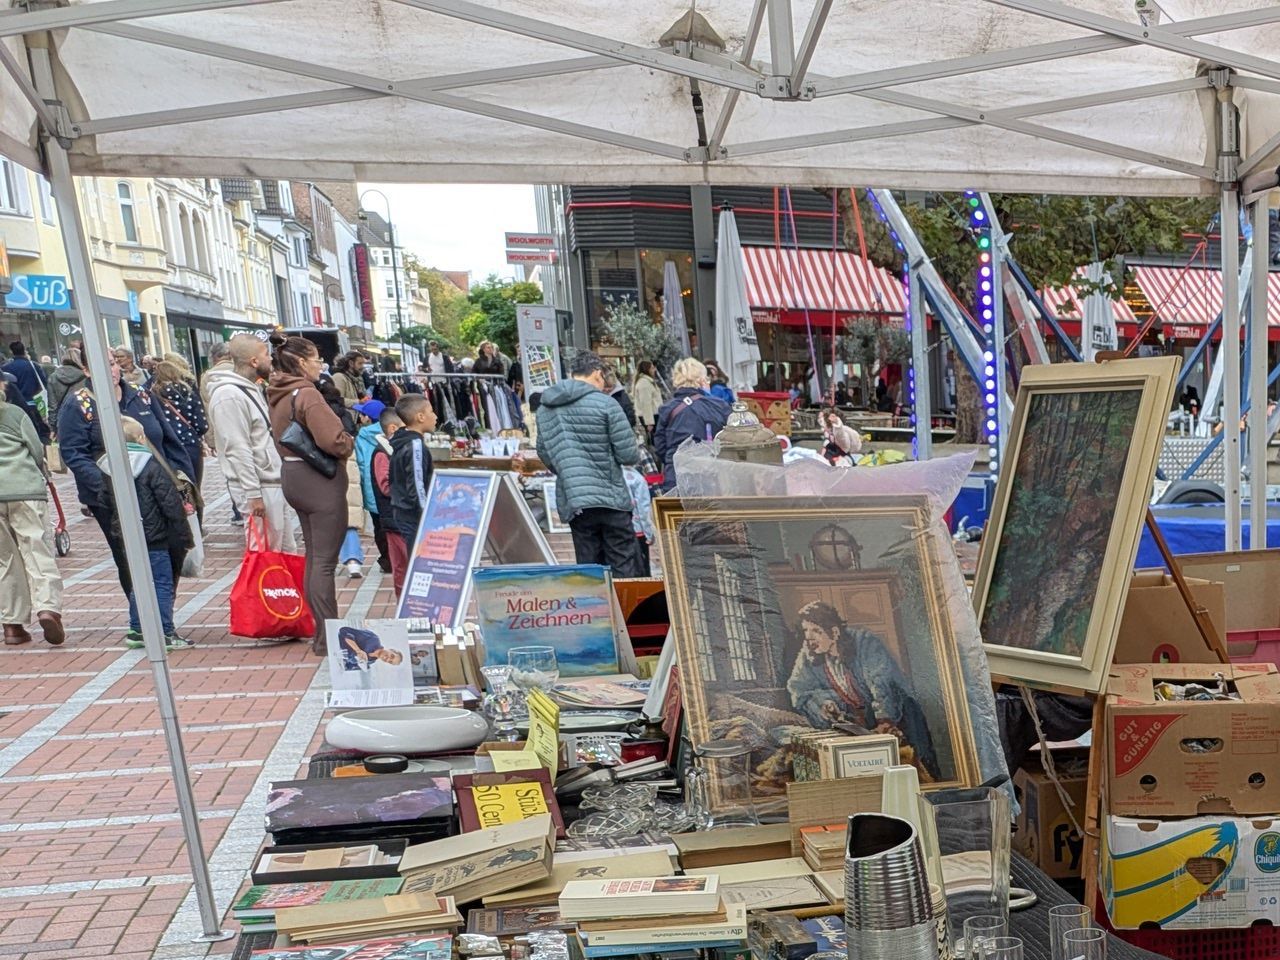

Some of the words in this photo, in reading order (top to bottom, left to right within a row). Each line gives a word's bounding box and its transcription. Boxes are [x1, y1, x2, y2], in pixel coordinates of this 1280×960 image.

[508, 236, 554, 245] WOOLWORTH
[6, 274, 68, 308] Süß
[506, 596, 561, 614] Malen
[564, 596, 577, 609] &
[508, 612, 592, 630] Zeichnen
[1118, 719, 1139, 742] GUT
[1130, 733, 1141, 743] &
[1123, 720, 1162, 764] GÜNSTIG
[847, 758, 884, 768] VOLTAIRE
[515, 788, 546, 820] Stück
[730, 928, 744, 936] dtv
